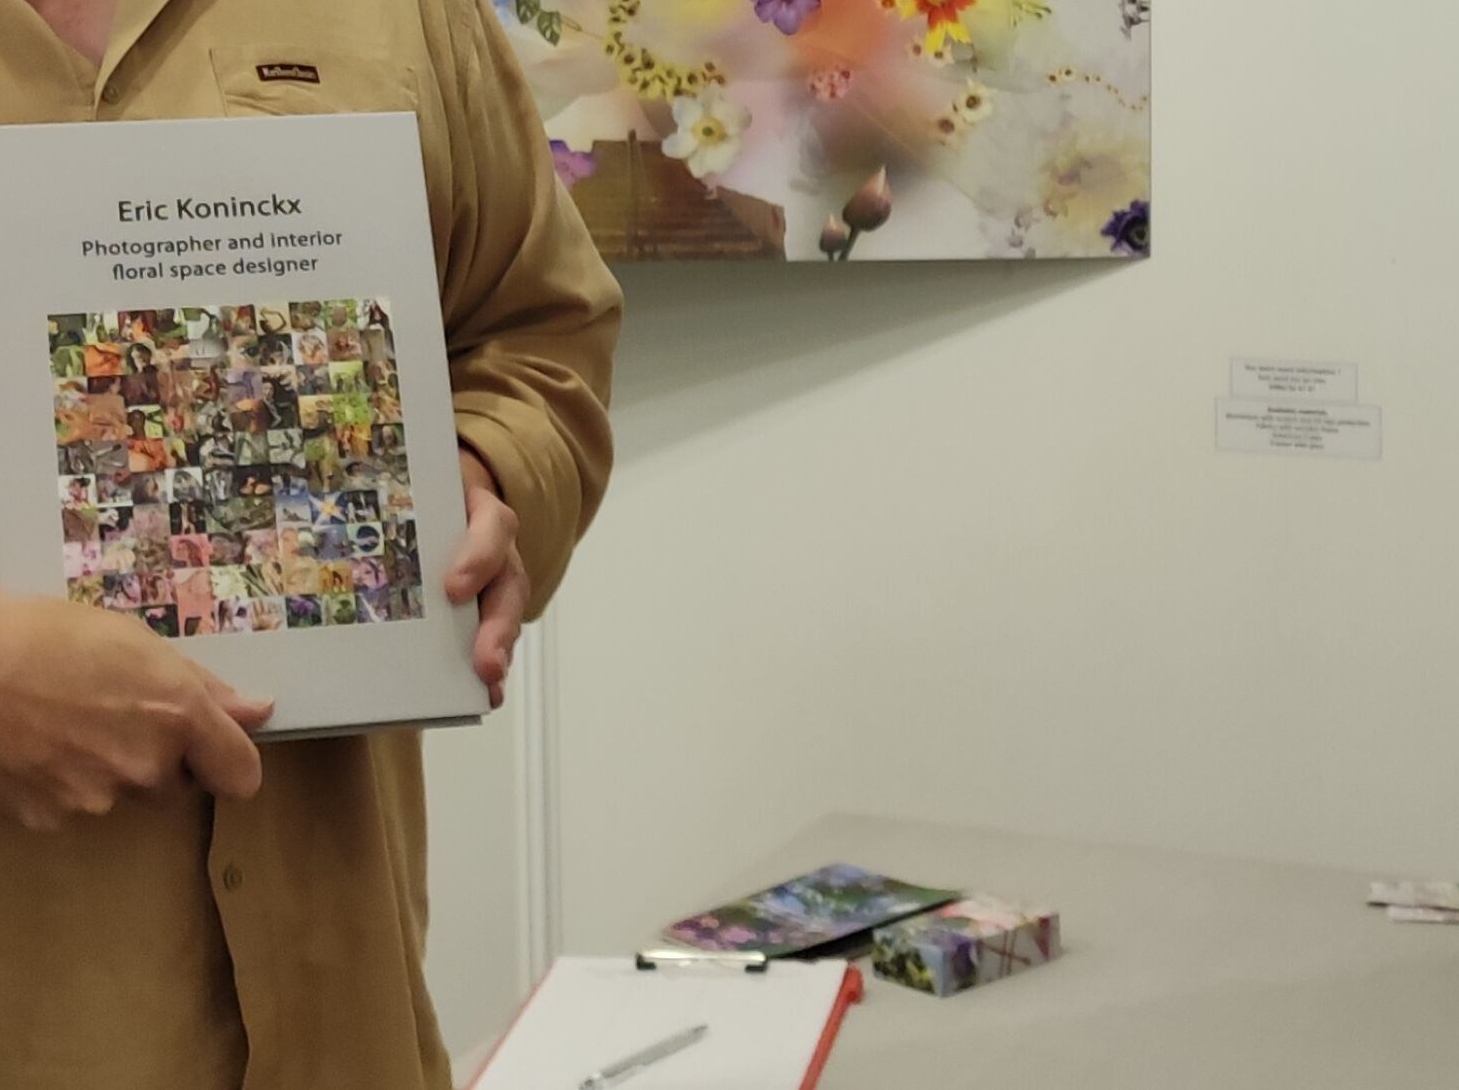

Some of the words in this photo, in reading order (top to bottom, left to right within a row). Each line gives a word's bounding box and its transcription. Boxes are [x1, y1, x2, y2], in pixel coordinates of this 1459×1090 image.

[117, 200, 169, 222] Eric
[176, 194, 302, 219] Koninckx
[82, 235, 222, 258] Photographer
[228, 232, 265, 249] and
[270, 230, 343, 248] interior
[112, 261, 163, 281] floral
[169, 262, 227, 281] space
[233, 257, 319, 276] designer
